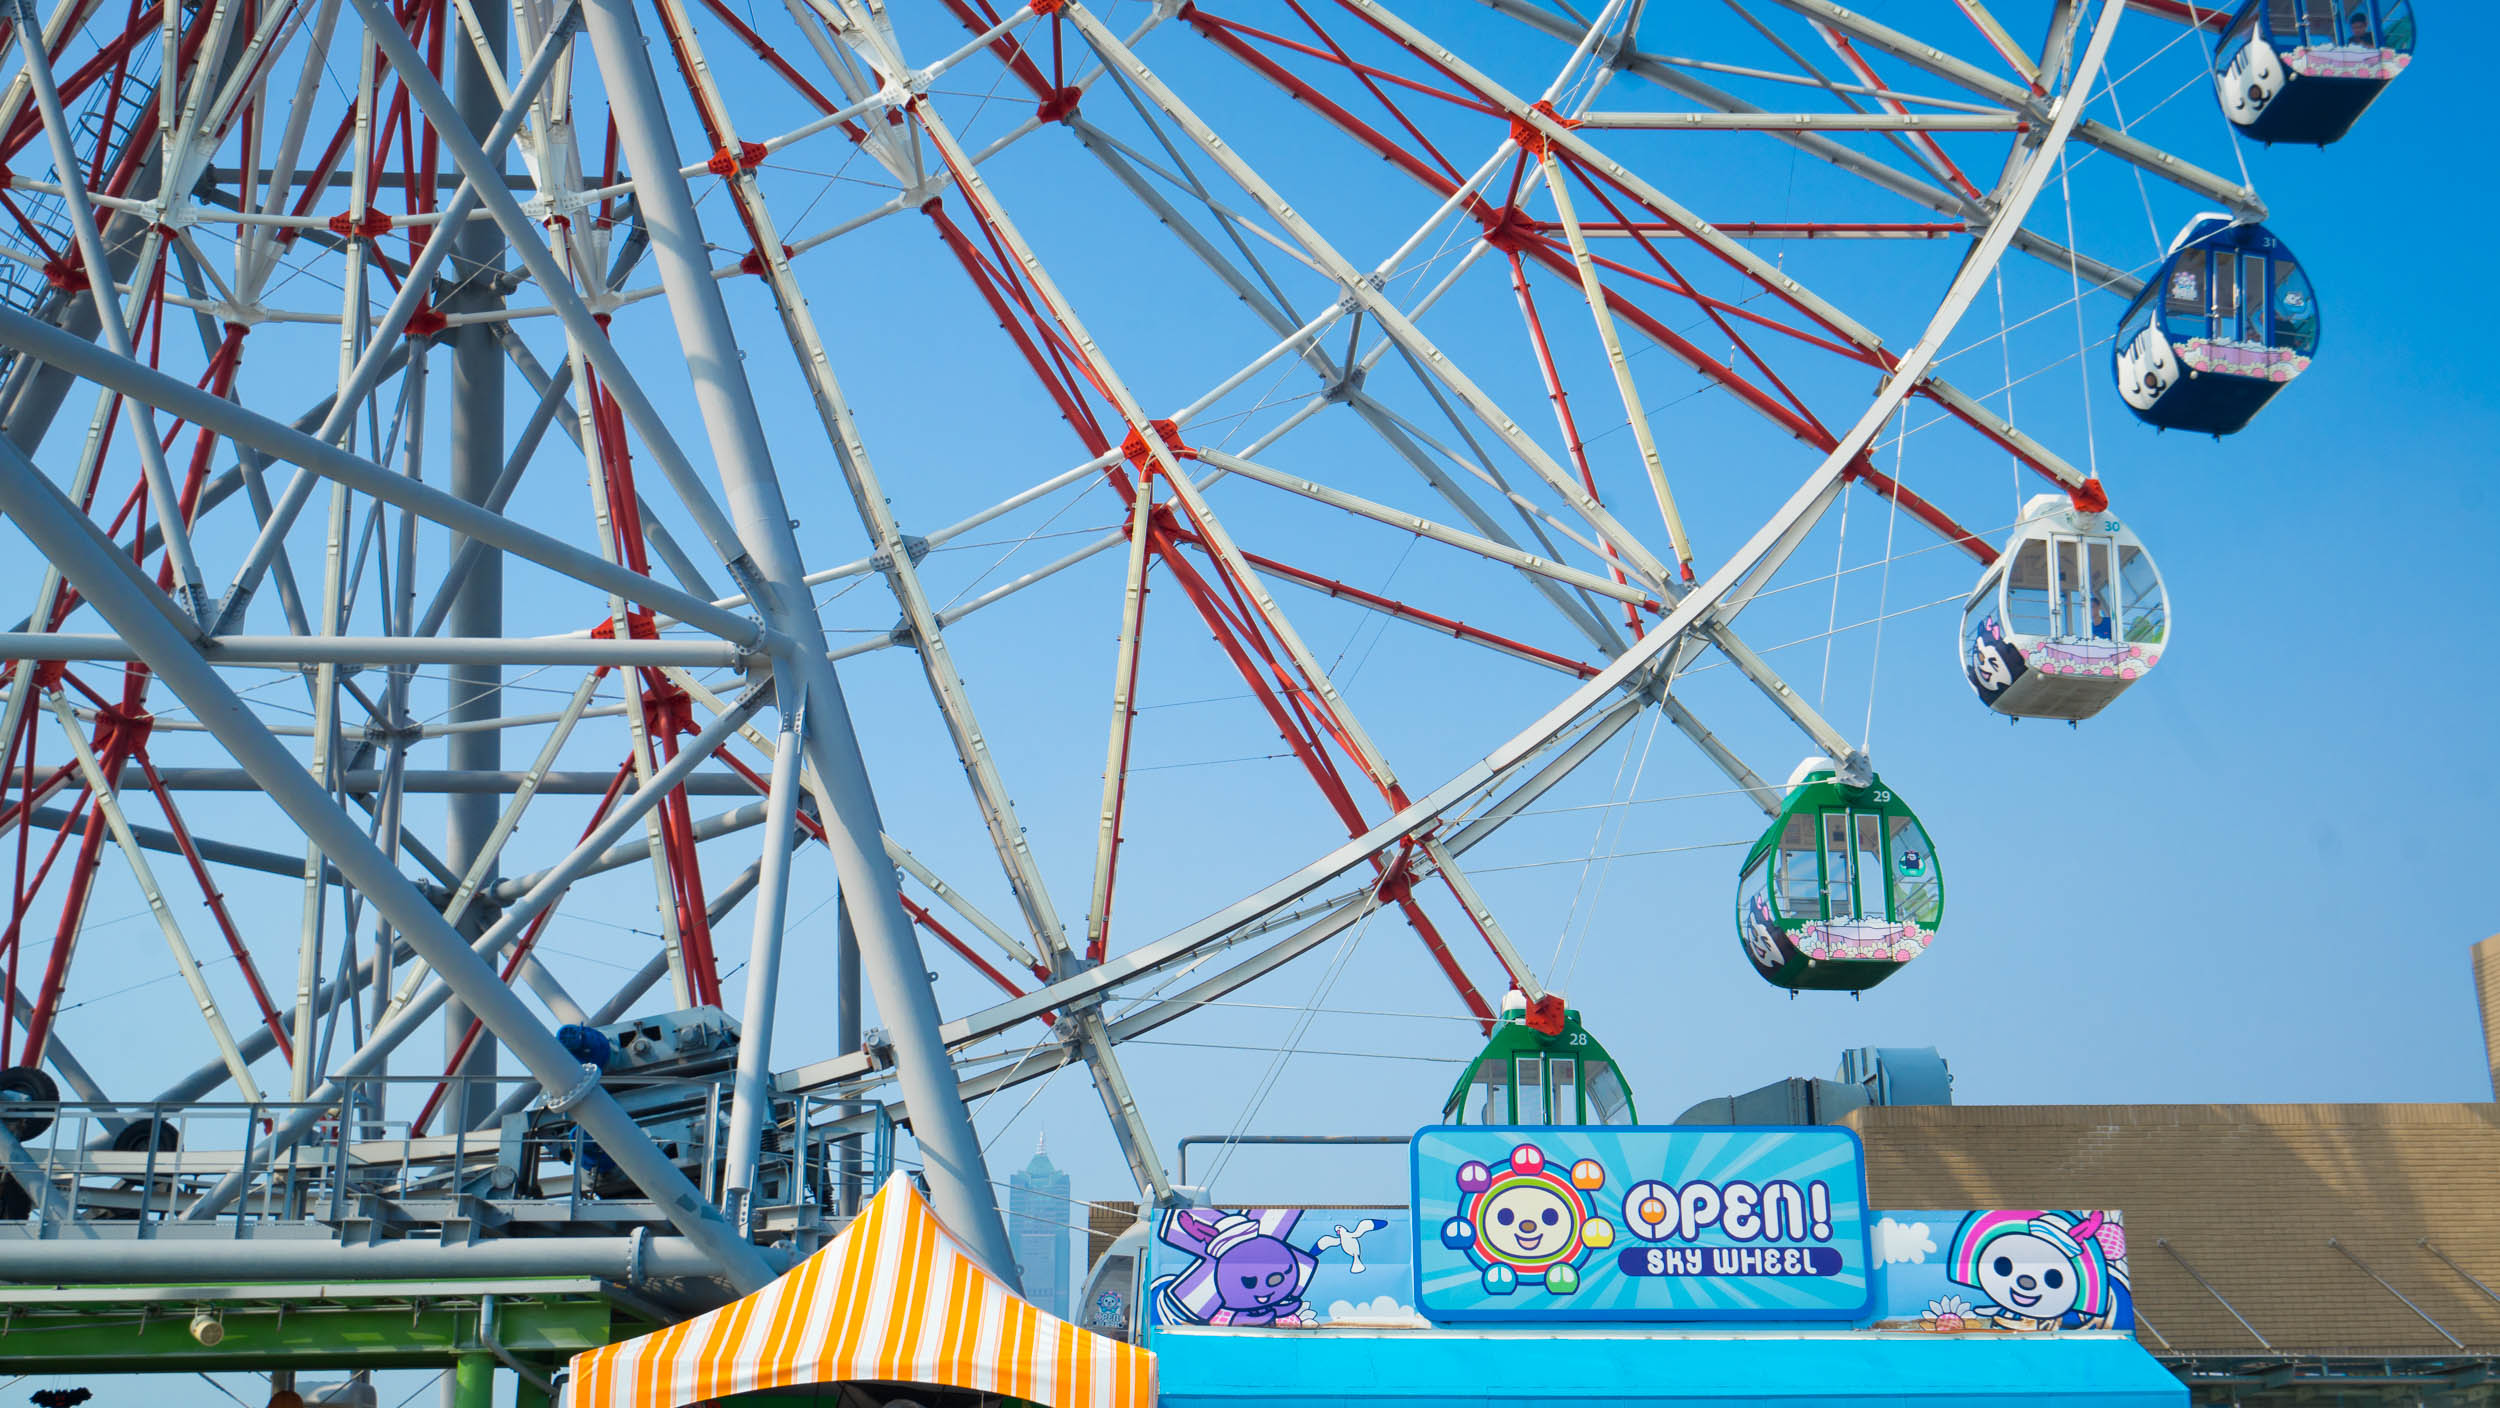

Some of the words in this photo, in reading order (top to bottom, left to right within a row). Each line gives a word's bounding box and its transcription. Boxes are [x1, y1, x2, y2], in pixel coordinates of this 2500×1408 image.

[2263, 237, 2276, 248] 31
[2104, 521, 2120, 532] 30
[1873, 790, 1891, 802] 29
[1569, 1033, 1587, 1046] 28
[1622, 1180, 1833, 1242] OPEN!
[1647, 1249, 1703, 1275] SKY
[1712, 1249, 1818, 1275] WHEEL
